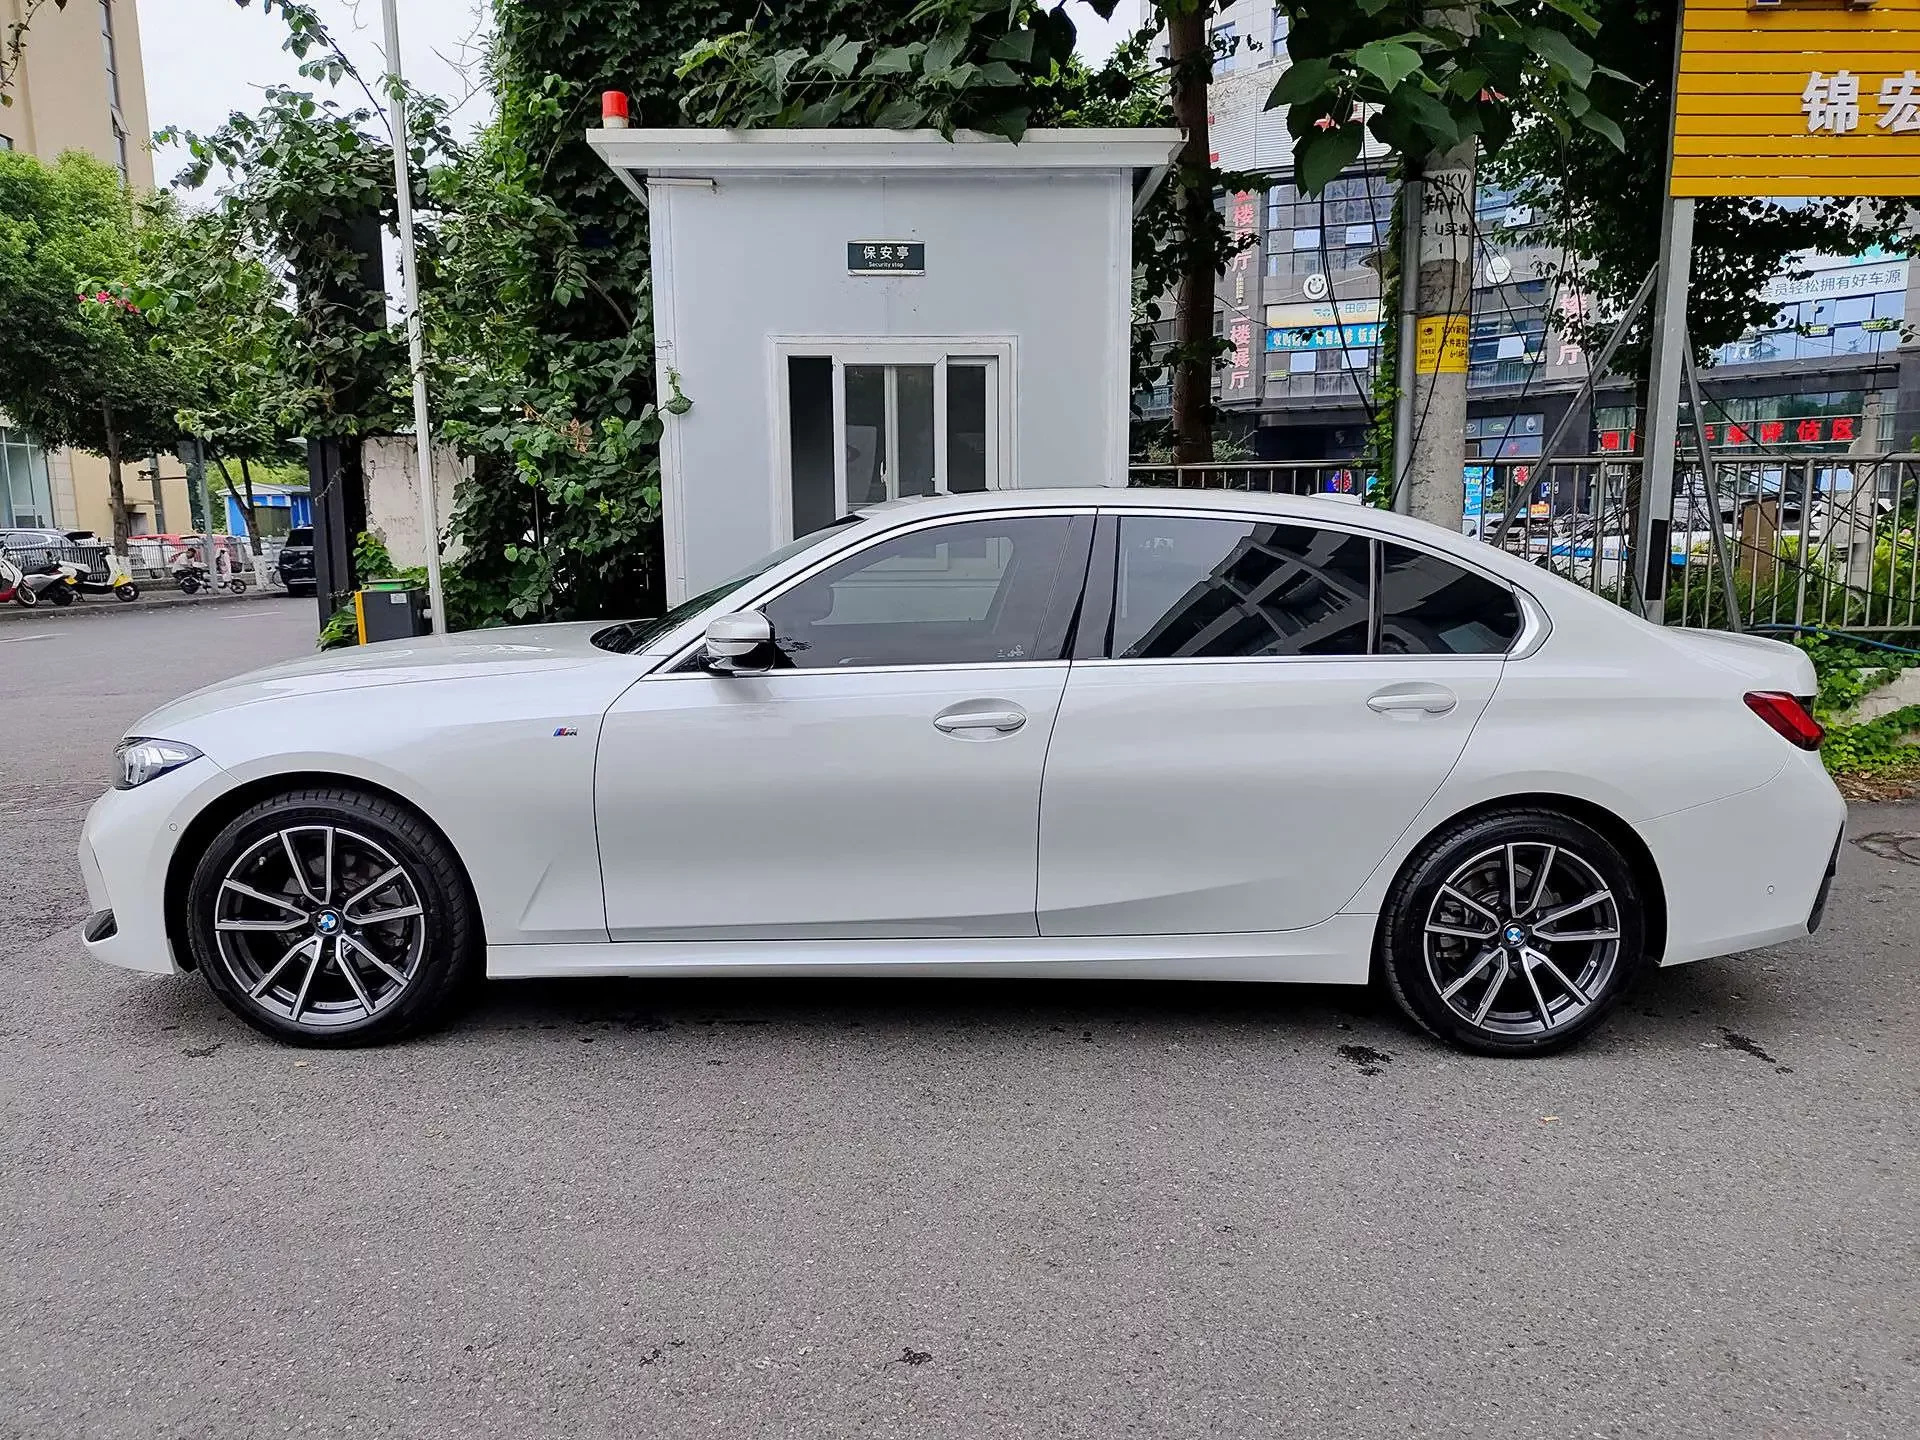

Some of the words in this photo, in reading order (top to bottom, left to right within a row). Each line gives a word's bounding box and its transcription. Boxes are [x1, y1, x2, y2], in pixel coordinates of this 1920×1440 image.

[863, 245, 910, 260] 保安亭
[868, 261, 891, 269] Security
